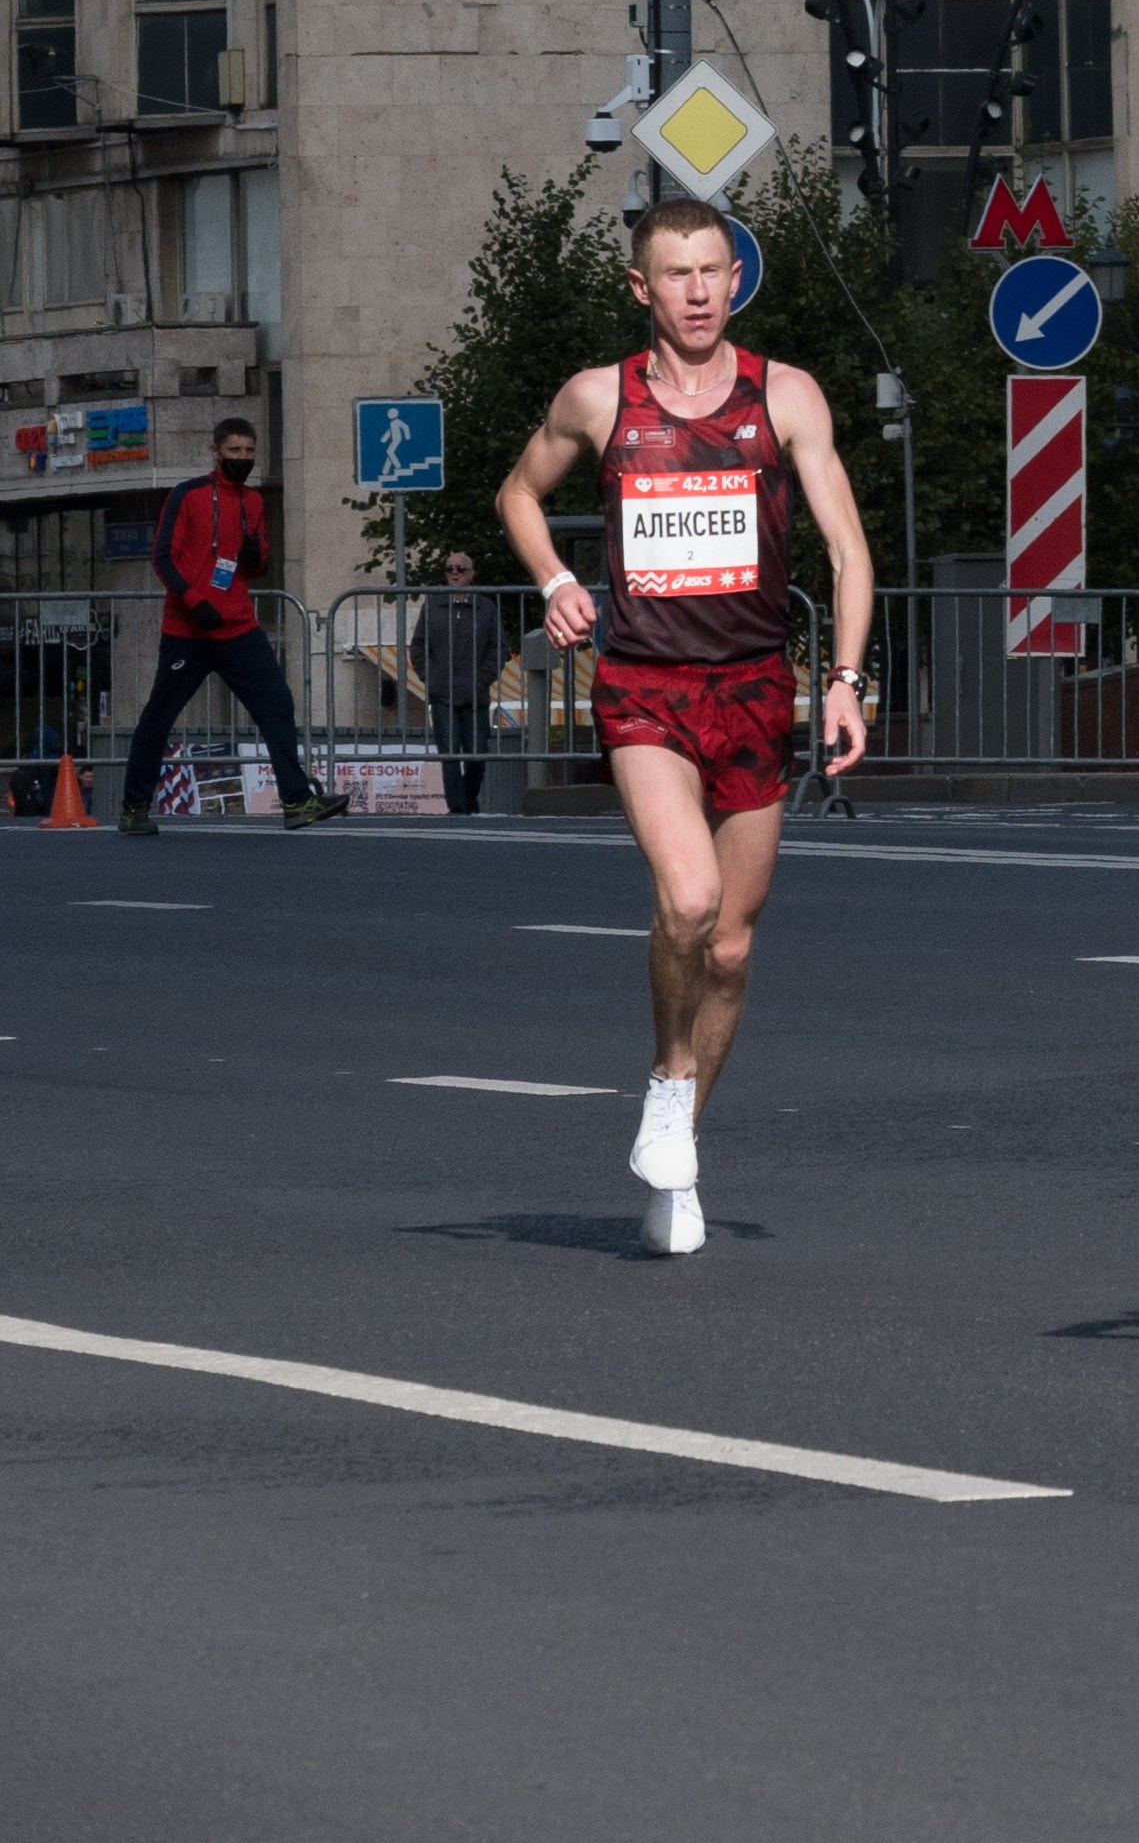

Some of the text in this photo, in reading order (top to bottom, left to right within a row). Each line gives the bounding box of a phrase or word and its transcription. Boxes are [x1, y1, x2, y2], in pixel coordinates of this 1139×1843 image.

[682, 475, 718, 492] 42,2
[633, 509, 746, 539] АЛЕКСЕЕВ
[687, 550, 694, 561] 2
[359, 765, 420, 777] СЕЗОНЫ
